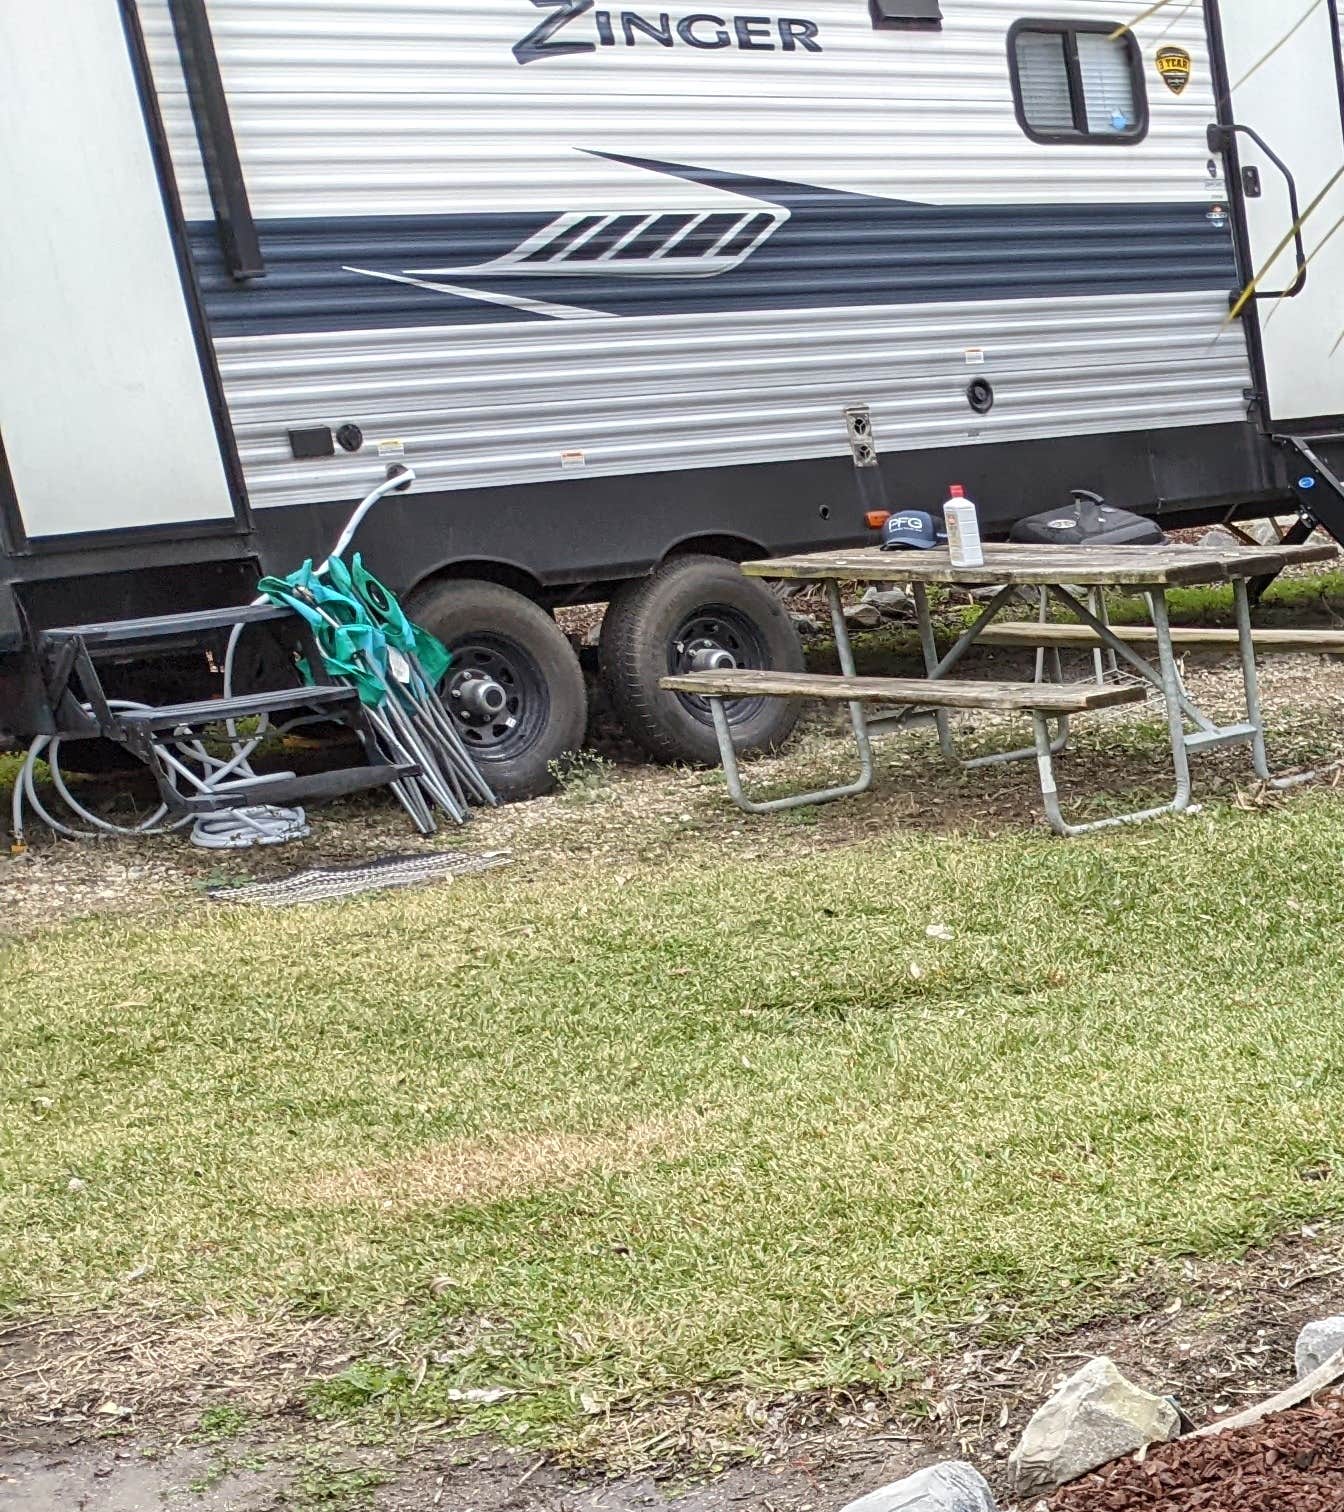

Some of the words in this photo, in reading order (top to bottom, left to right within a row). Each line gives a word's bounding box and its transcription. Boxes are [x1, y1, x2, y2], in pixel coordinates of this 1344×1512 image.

[511, 0, 824, 66] ZINGER
[1165, 58, 1188, 69] YEAR
[888, 517, 923, 529] PFG
